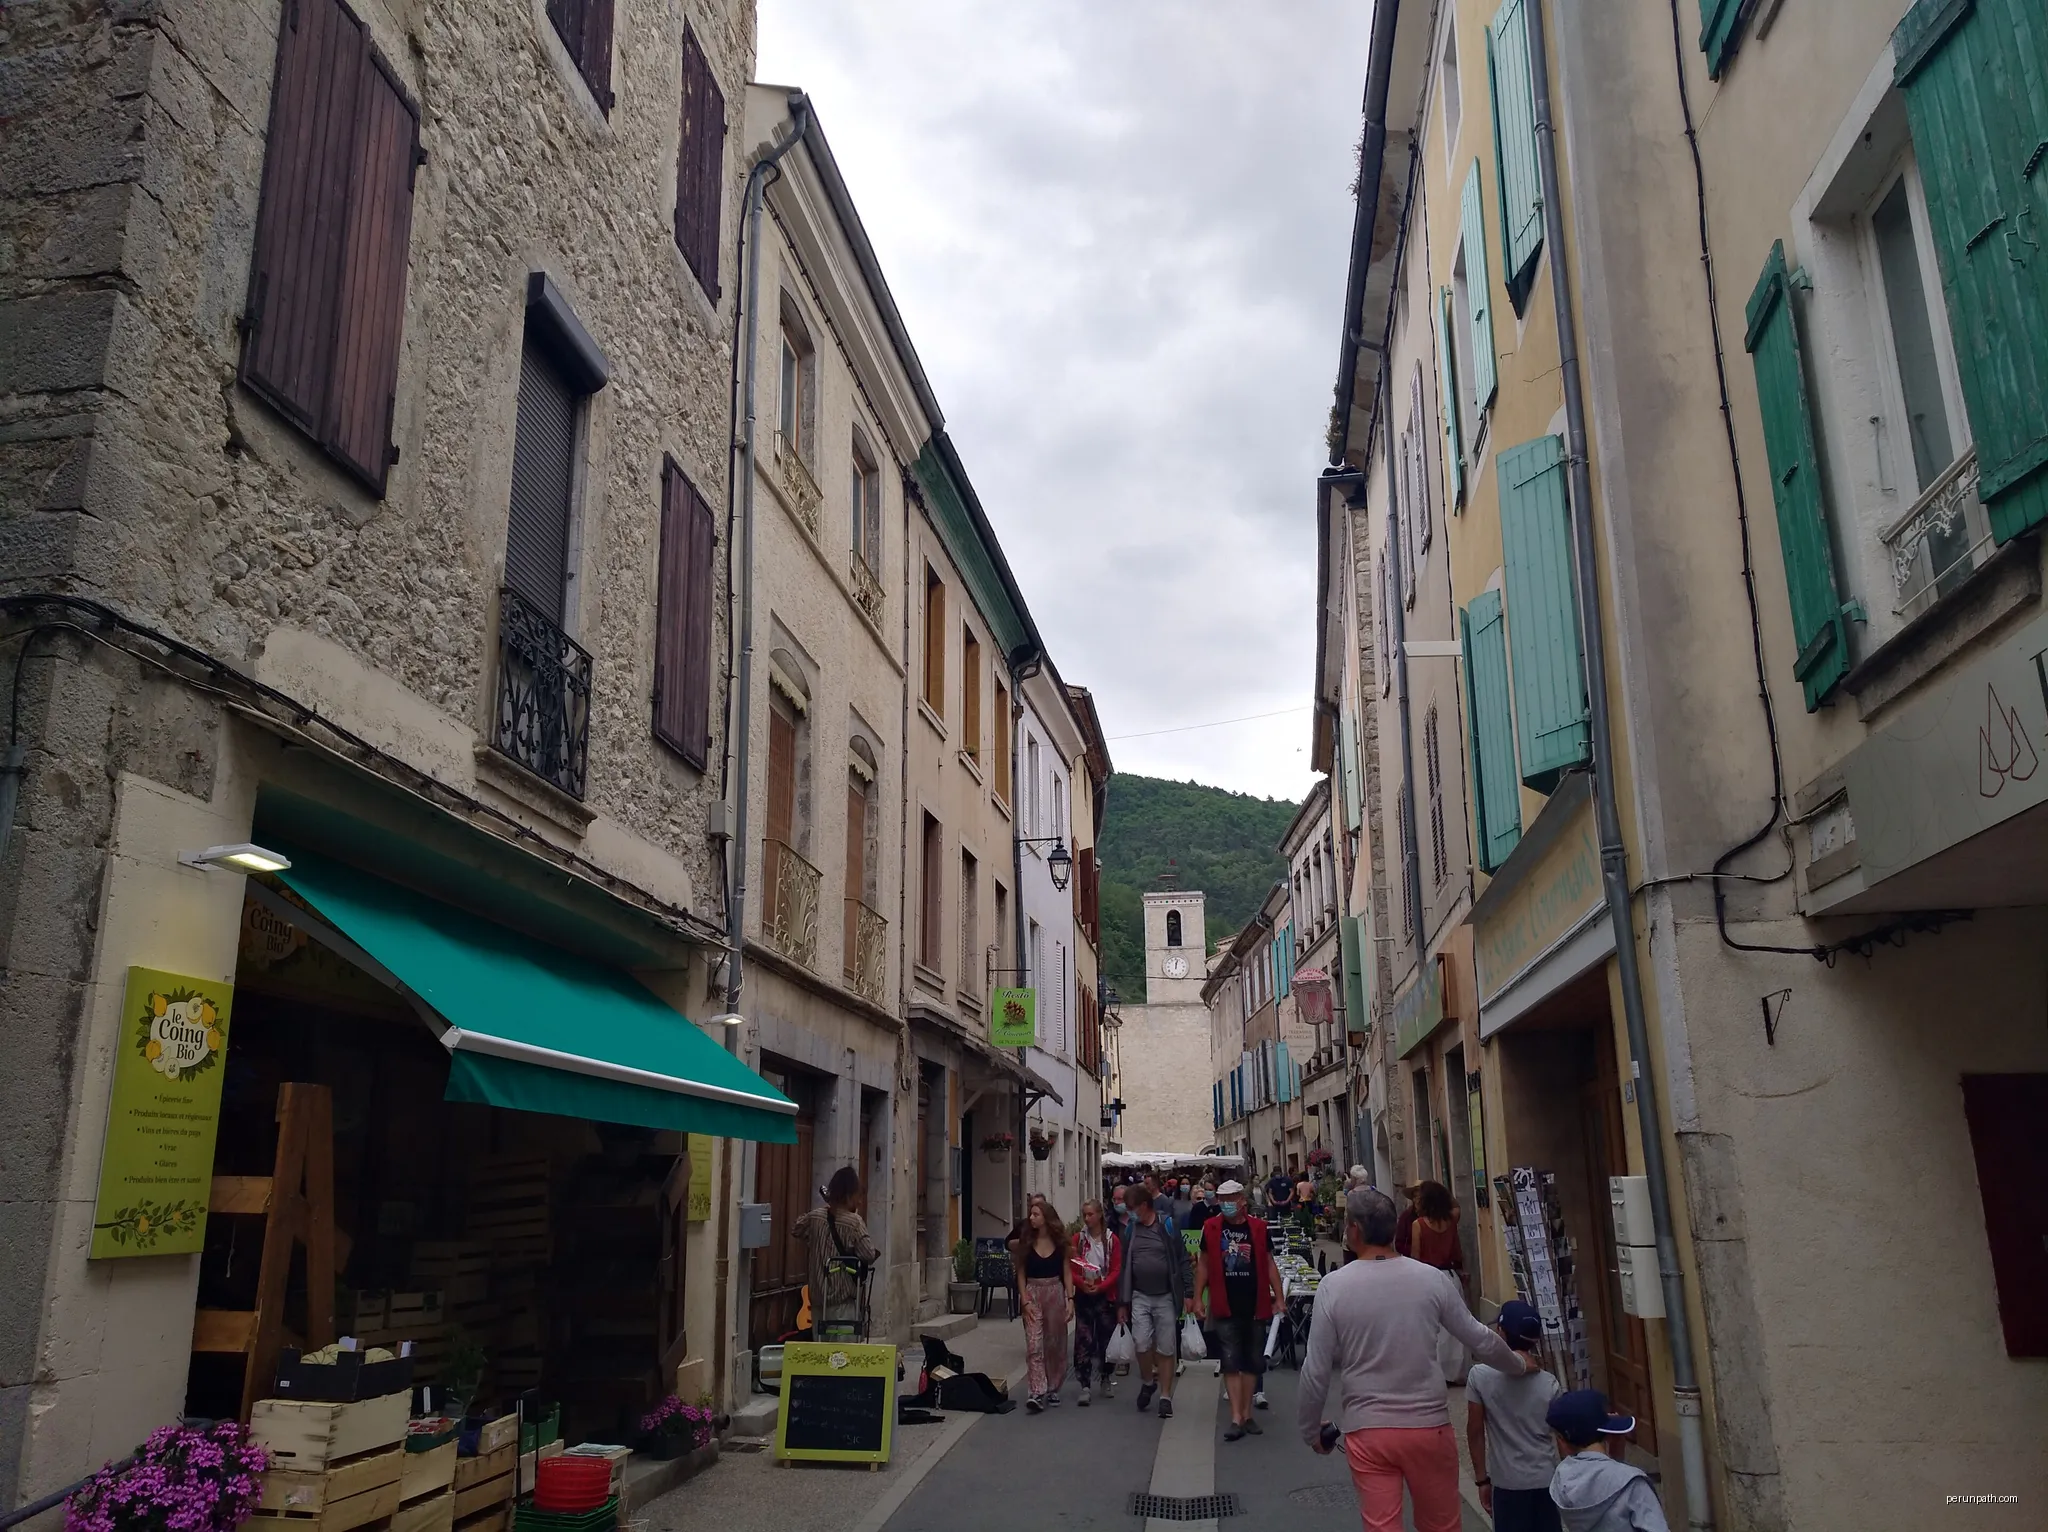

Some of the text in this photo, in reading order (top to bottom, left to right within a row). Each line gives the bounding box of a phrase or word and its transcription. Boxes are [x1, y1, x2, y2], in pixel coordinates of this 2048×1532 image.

[250, 908, 292, 944] Coing
[266, 934, 284, 953] Bio
[172, 1008, 182, 1024] le
[159, 1018, 204, 1051] Coing
[176, 1043, 195, 1061] Bio
[181, 1096, 194, 1104] fine
[133, 1108, 159, 1118] Produits
[159, 1111, 178, 1119] locaux
[141, 1126, 155, 1134] Vins
[188, 1129, 202, 1138] pays
[163, 1143, 177, 1151] Vrac
[159, 1160, 178, 1168] Glaces
[128, 1176, 154, 1184] Produits
[155, 1176, 168, 1184] bien
